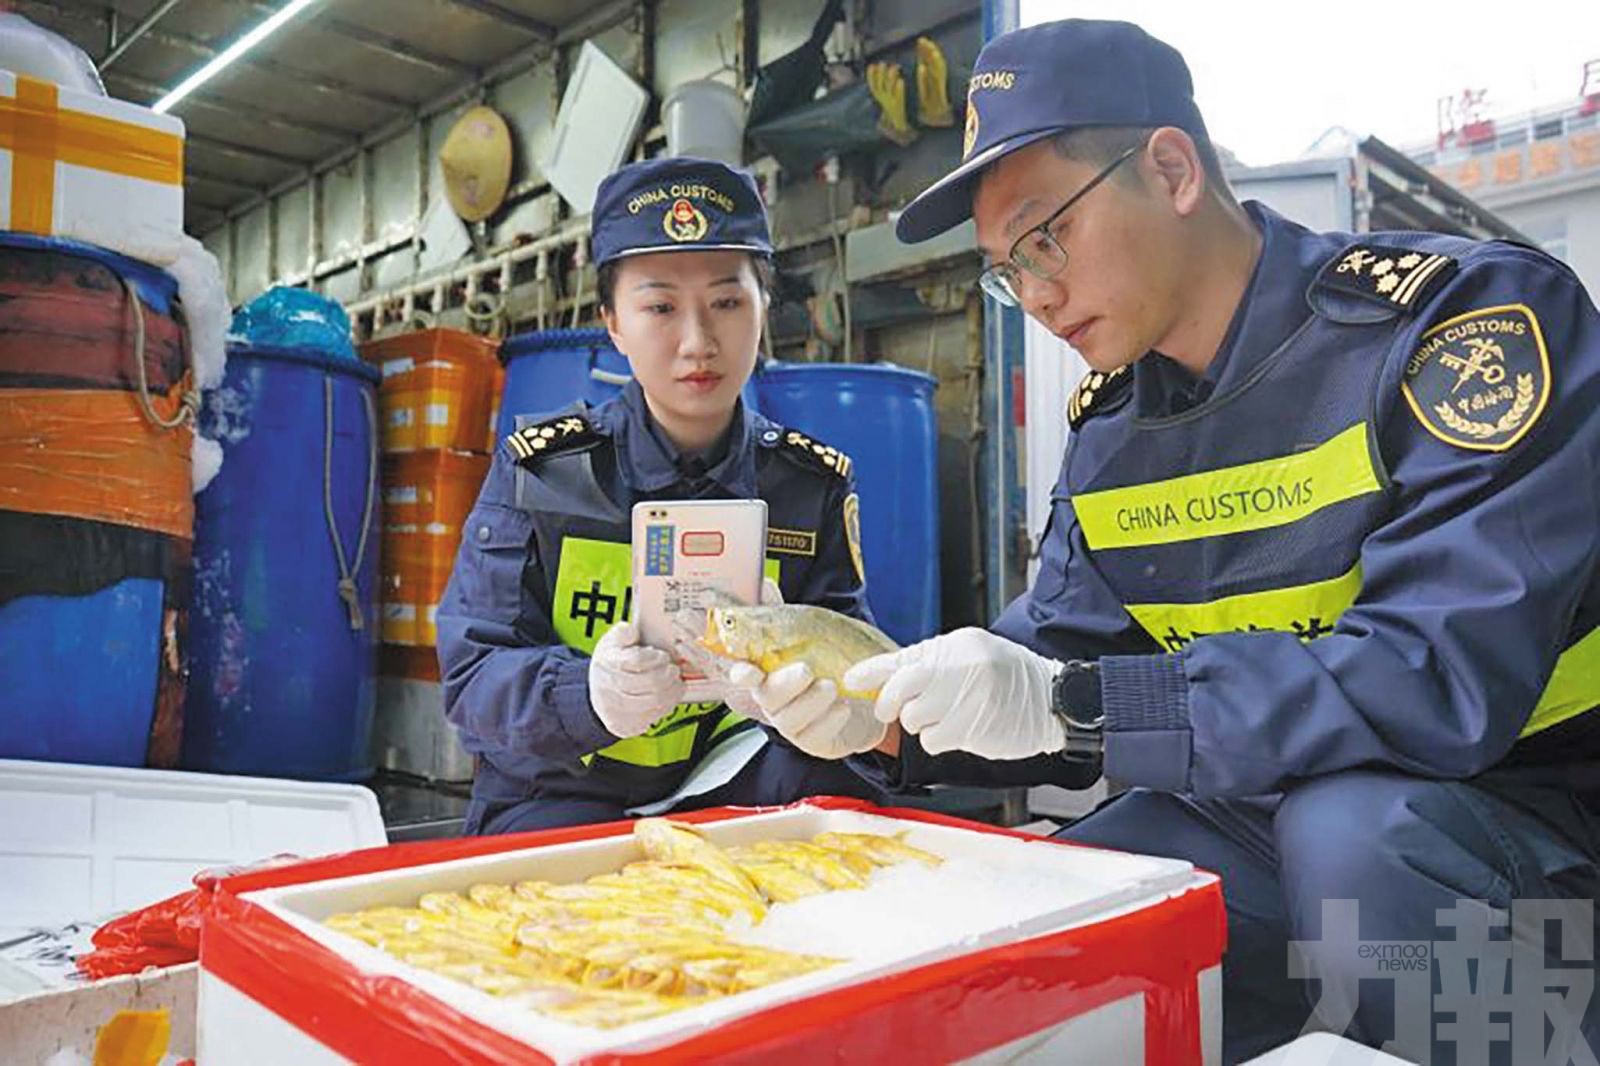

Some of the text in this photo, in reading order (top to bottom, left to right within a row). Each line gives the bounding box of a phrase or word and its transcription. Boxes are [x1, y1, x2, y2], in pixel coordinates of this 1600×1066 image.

[628, 185, 735, 214] CHINA CUSTOMS
[1407, 319, 1526, 375] CHINA CUSTOMS
[1117, 477, 1313, 532] CHINA CUSTOMS
